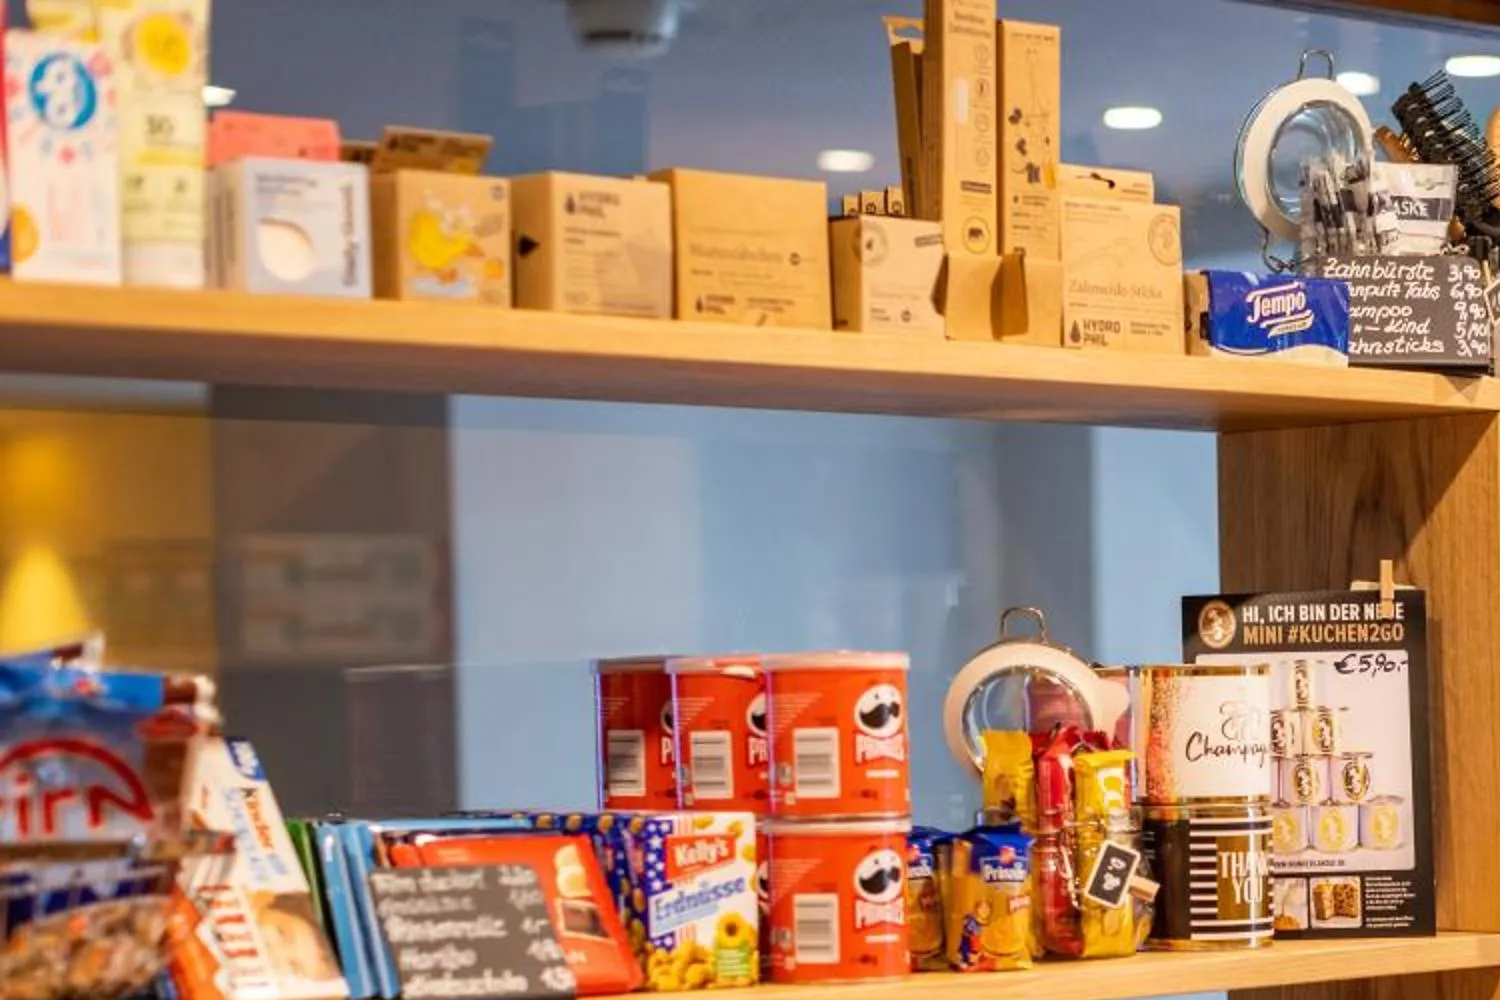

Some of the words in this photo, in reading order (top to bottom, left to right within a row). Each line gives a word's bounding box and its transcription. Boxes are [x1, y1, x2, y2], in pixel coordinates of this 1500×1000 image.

[1323, 257, 1435, 280] Zahnbürste
[1447, 264, 1481, 284] 3,90
[1404, 281, 1442, 300] Tabs
[1246, 281, 1306, 323] Tempo
[1349, 305, 1414, 325] ampoo
[1347, 336, 1446, 355] ahnsticks
[1269, 604, 1295, 622] ICH
[1299, 603, 1326, 622] BIN
[1329, 602, 1361, 621] DER
[1243, 624, 1283, 645] MINI
[1287, 622, 1405, 645] #KUCHEN2GO
[1231, 878, 1263, 905] YOU
